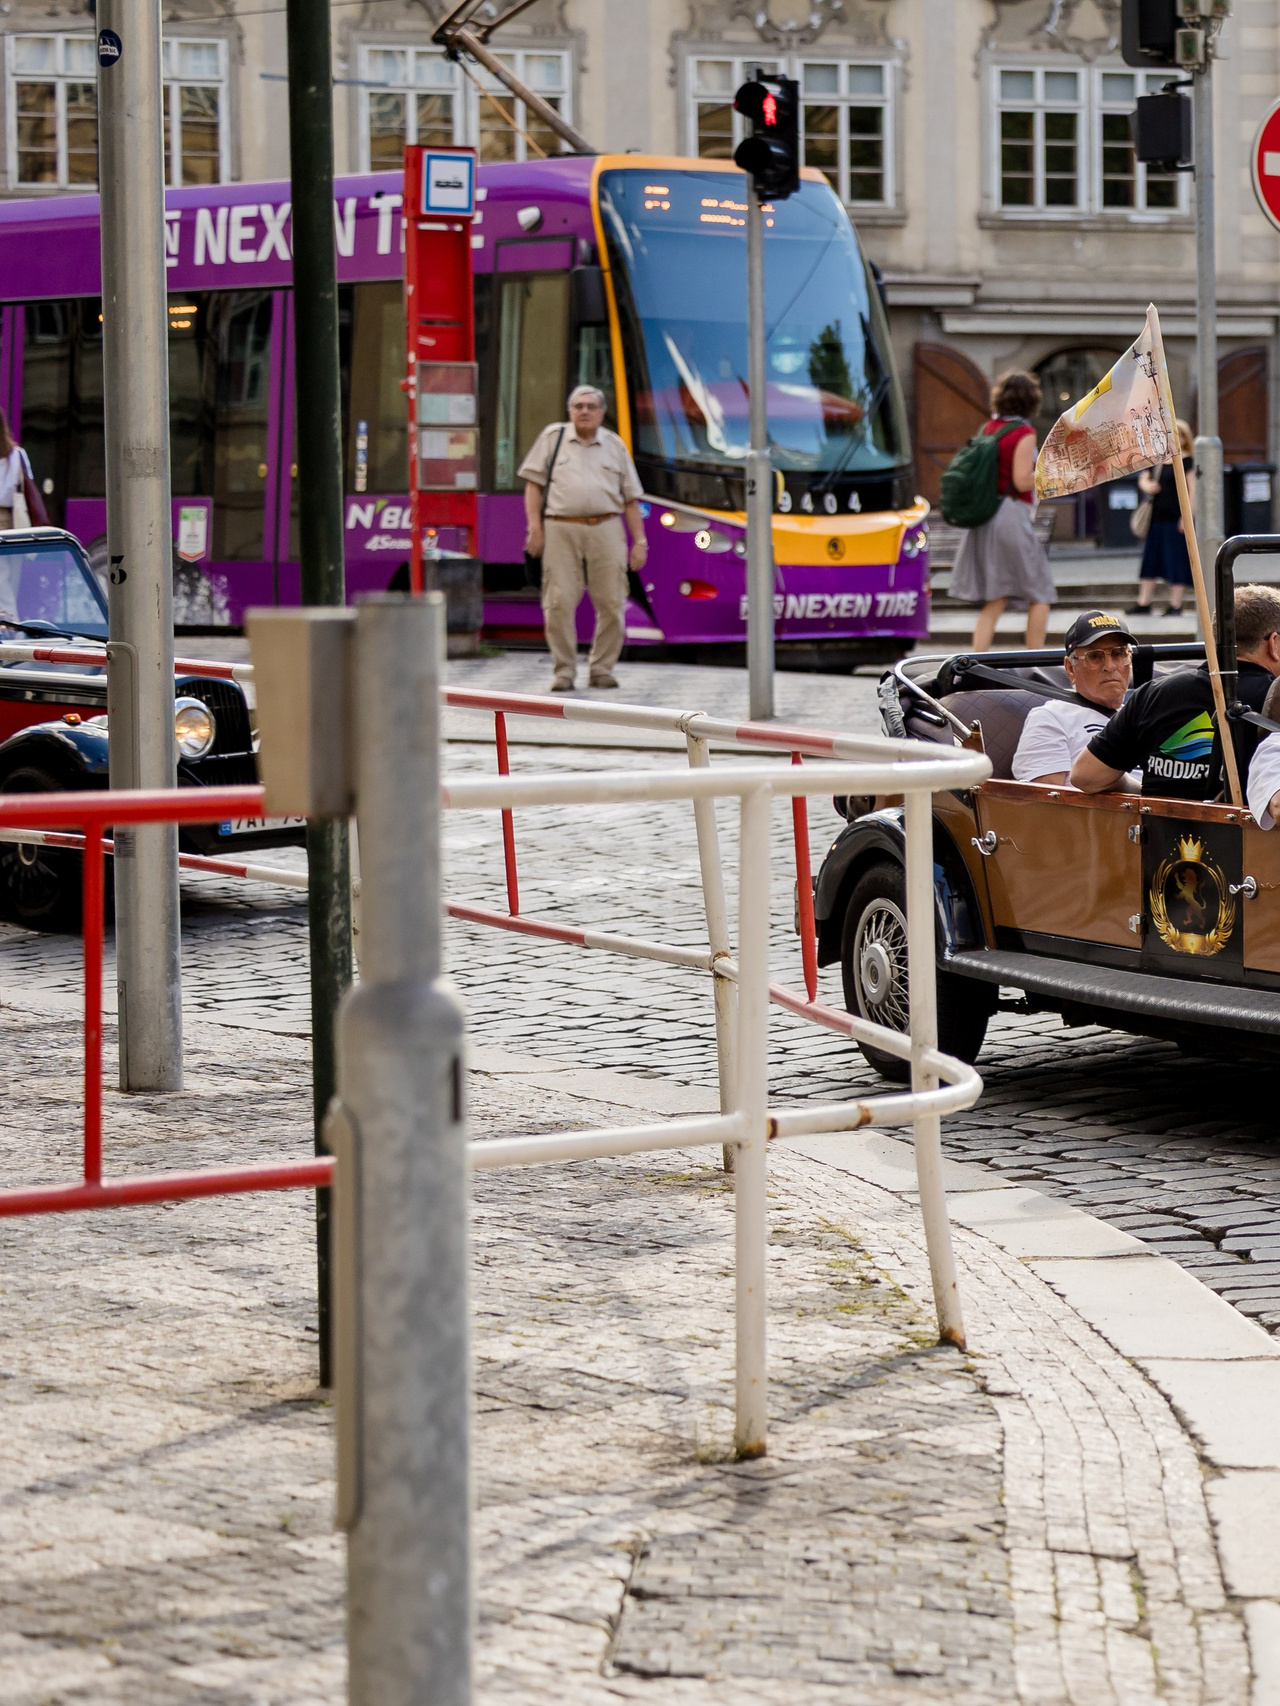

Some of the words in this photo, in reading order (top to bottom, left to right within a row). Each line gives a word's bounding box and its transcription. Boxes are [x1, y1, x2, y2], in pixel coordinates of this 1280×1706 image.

[194, 197, 357, 266] NEXN
[779, 490, 862, 514] 9404
[785, 592, 872, 619] NEXEN
[874, 590, 919, 618] TIRE
